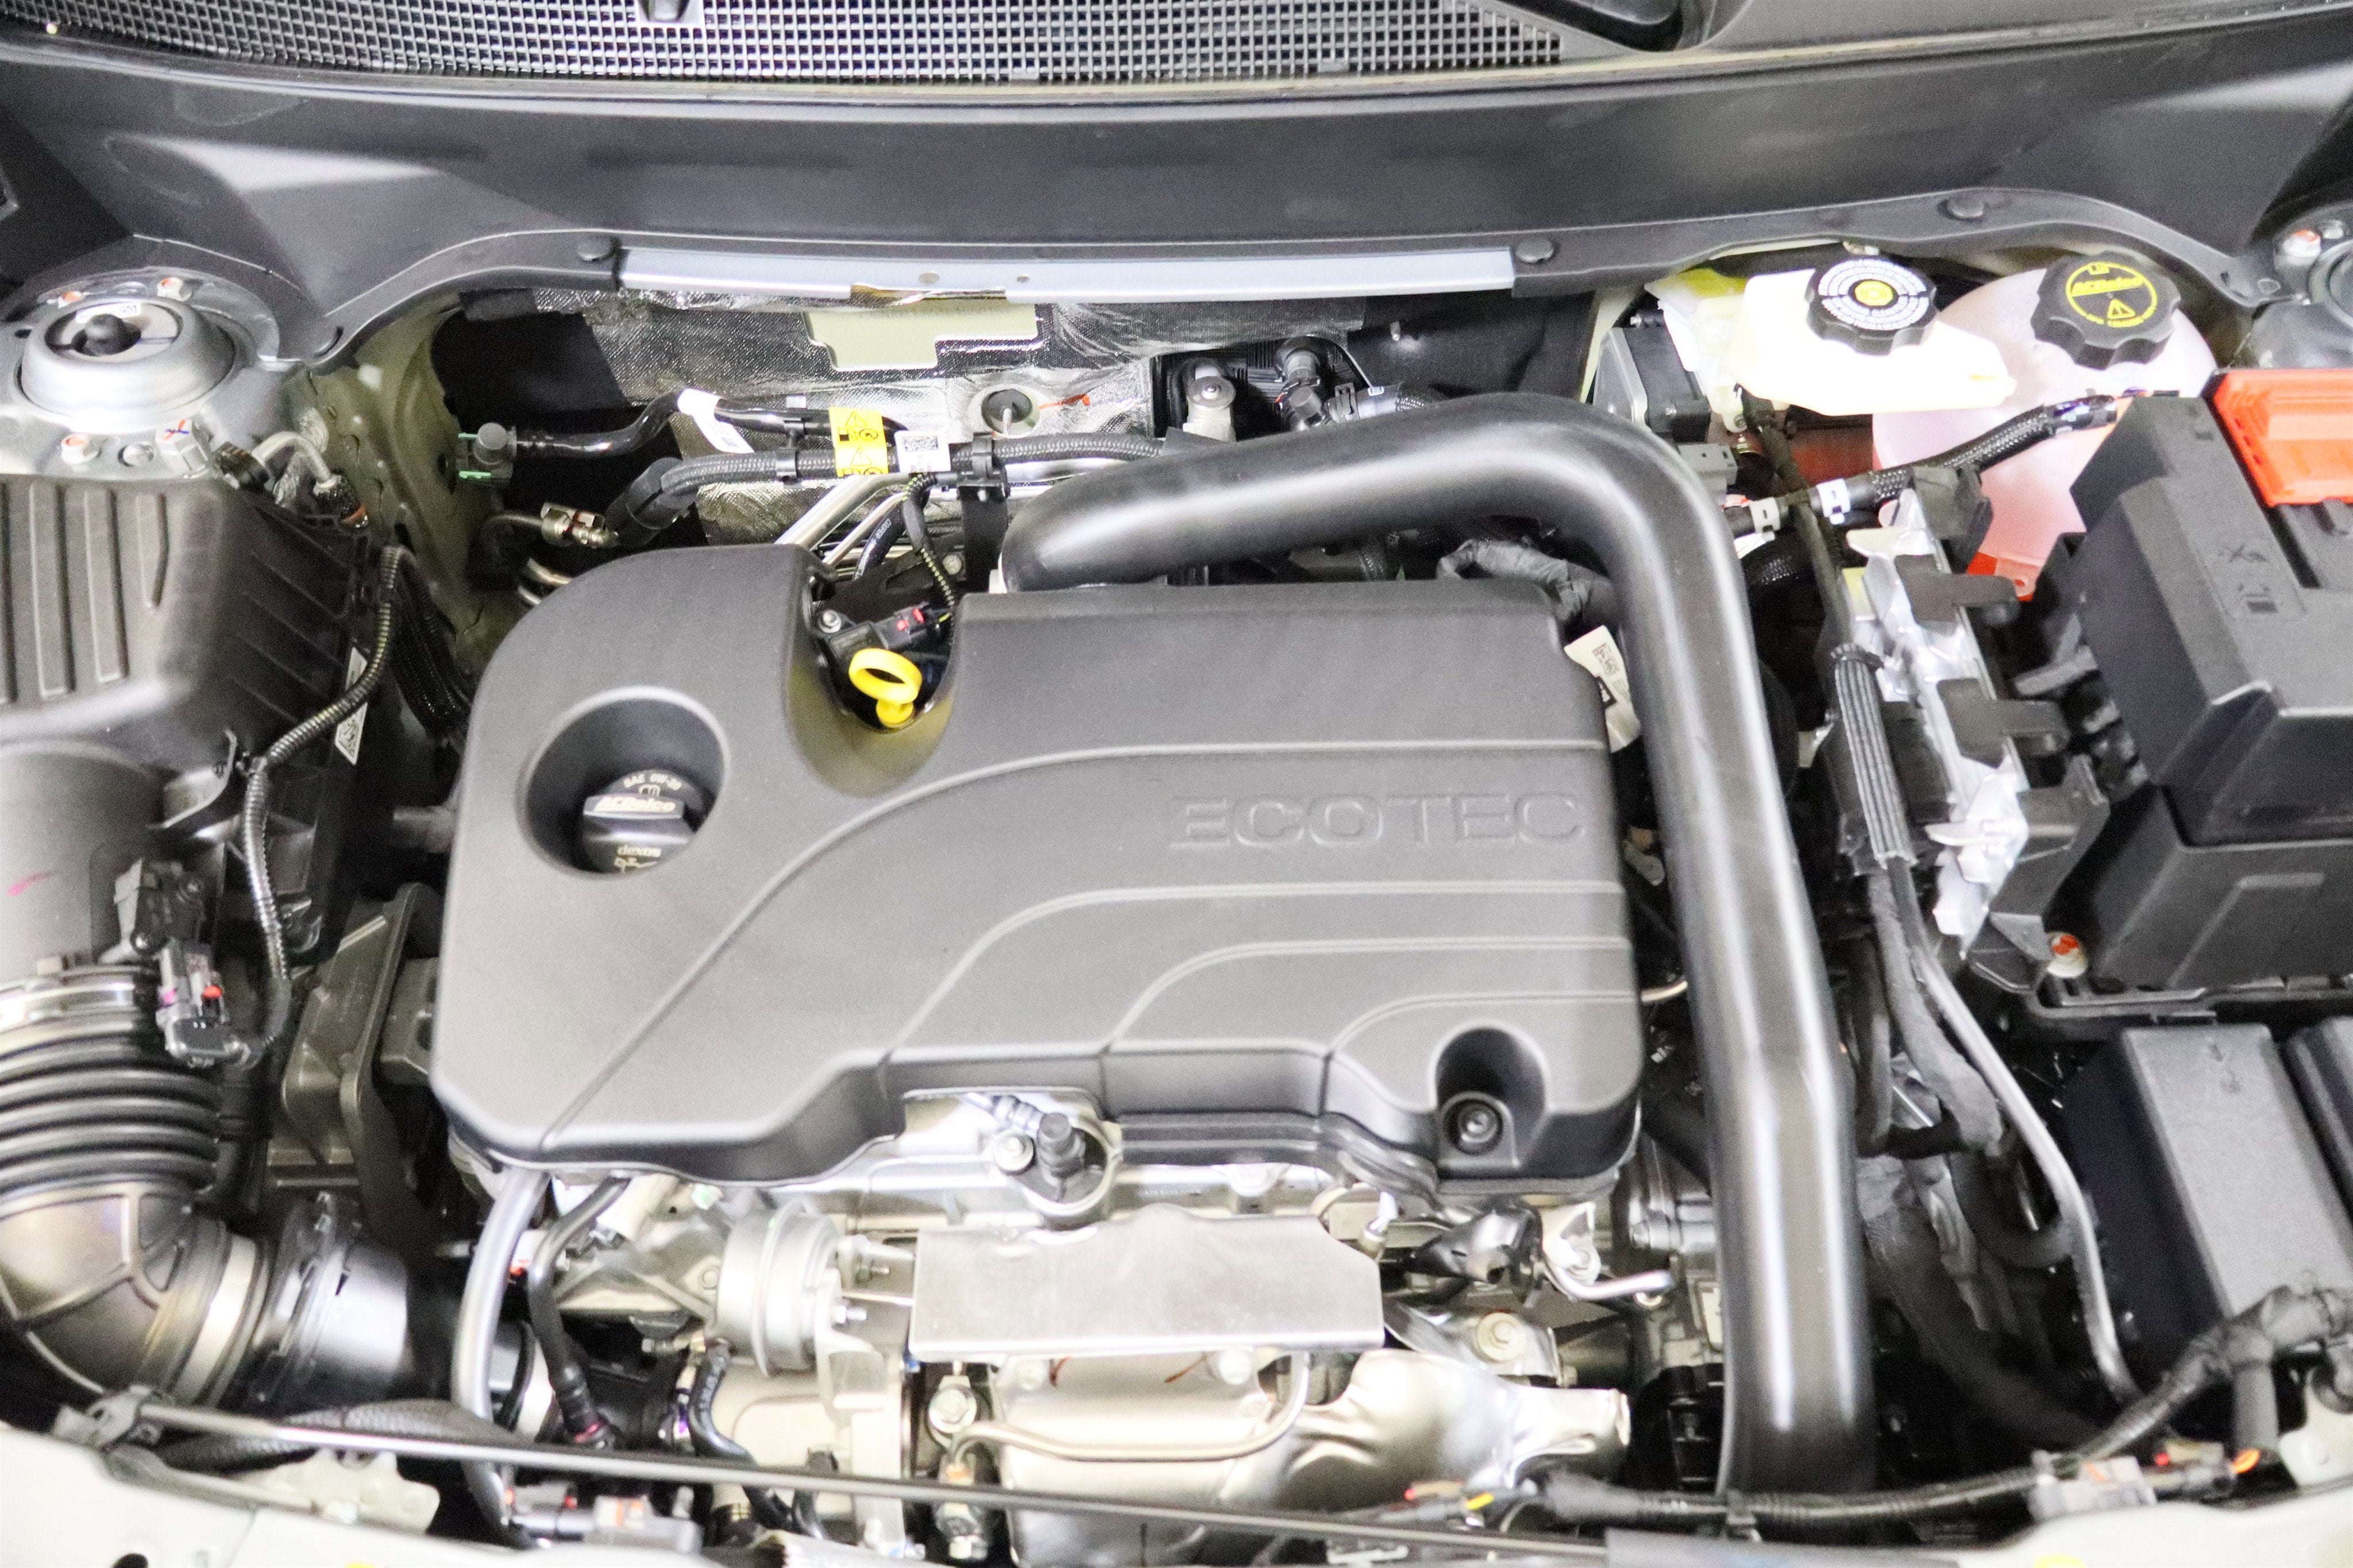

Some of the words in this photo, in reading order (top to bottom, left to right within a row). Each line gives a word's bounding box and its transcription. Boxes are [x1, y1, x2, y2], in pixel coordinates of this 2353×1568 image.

[624, 774, 645, 789] SAE
[650, 773, 682, 790] 0W-20
[593, 797, 676, 813] ACDelco
[1170, 794, 1586, 849] ECOTEC
